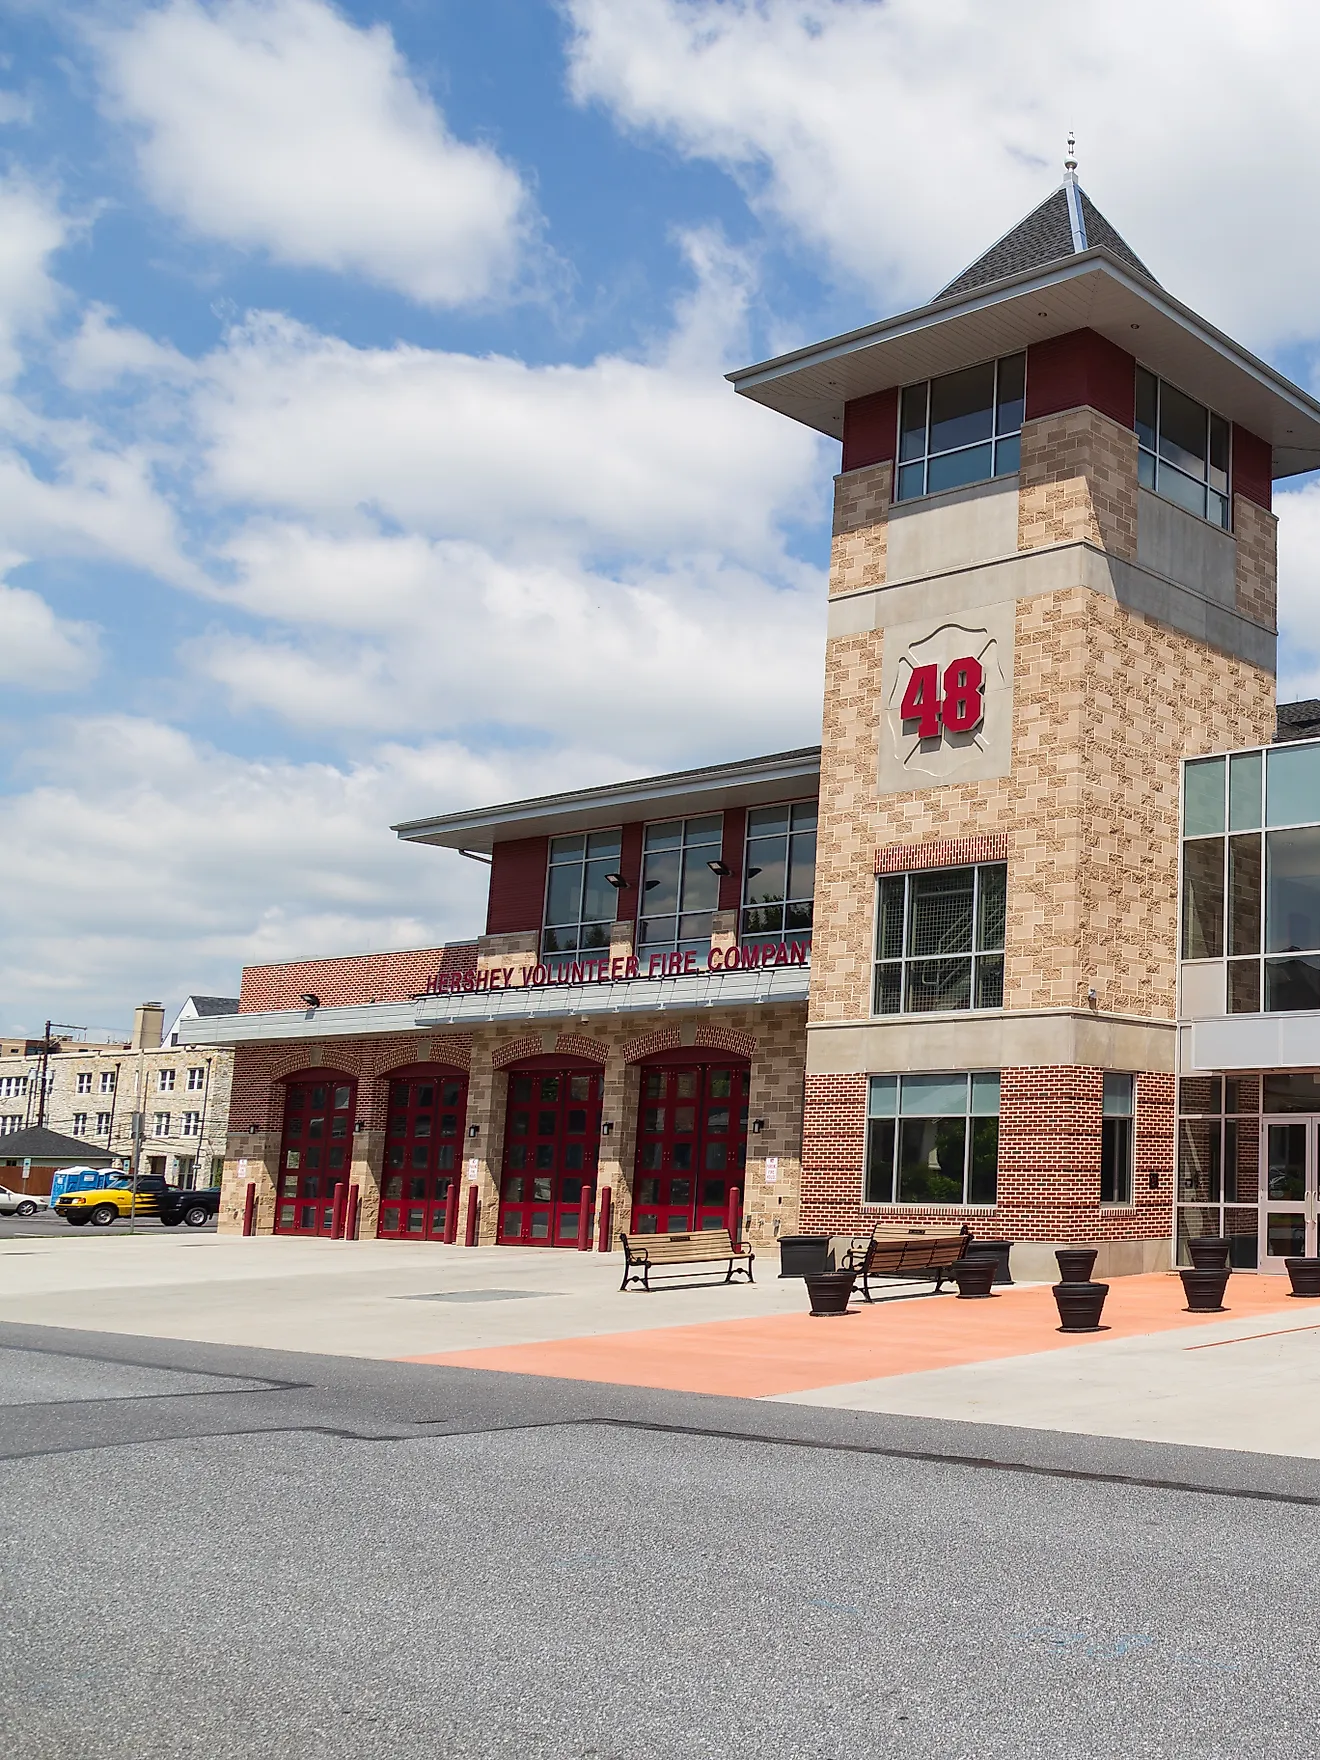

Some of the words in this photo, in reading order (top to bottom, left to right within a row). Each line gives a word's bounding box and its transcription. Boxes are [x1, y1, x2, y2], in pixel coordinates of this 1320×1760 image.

[900, 656, 984, 739] 48
[426, 966, 512, 994] HERSHEY
[522, 954, 640, 987] VOLUNTEER
[648, 948, 698, 977] FIRE
